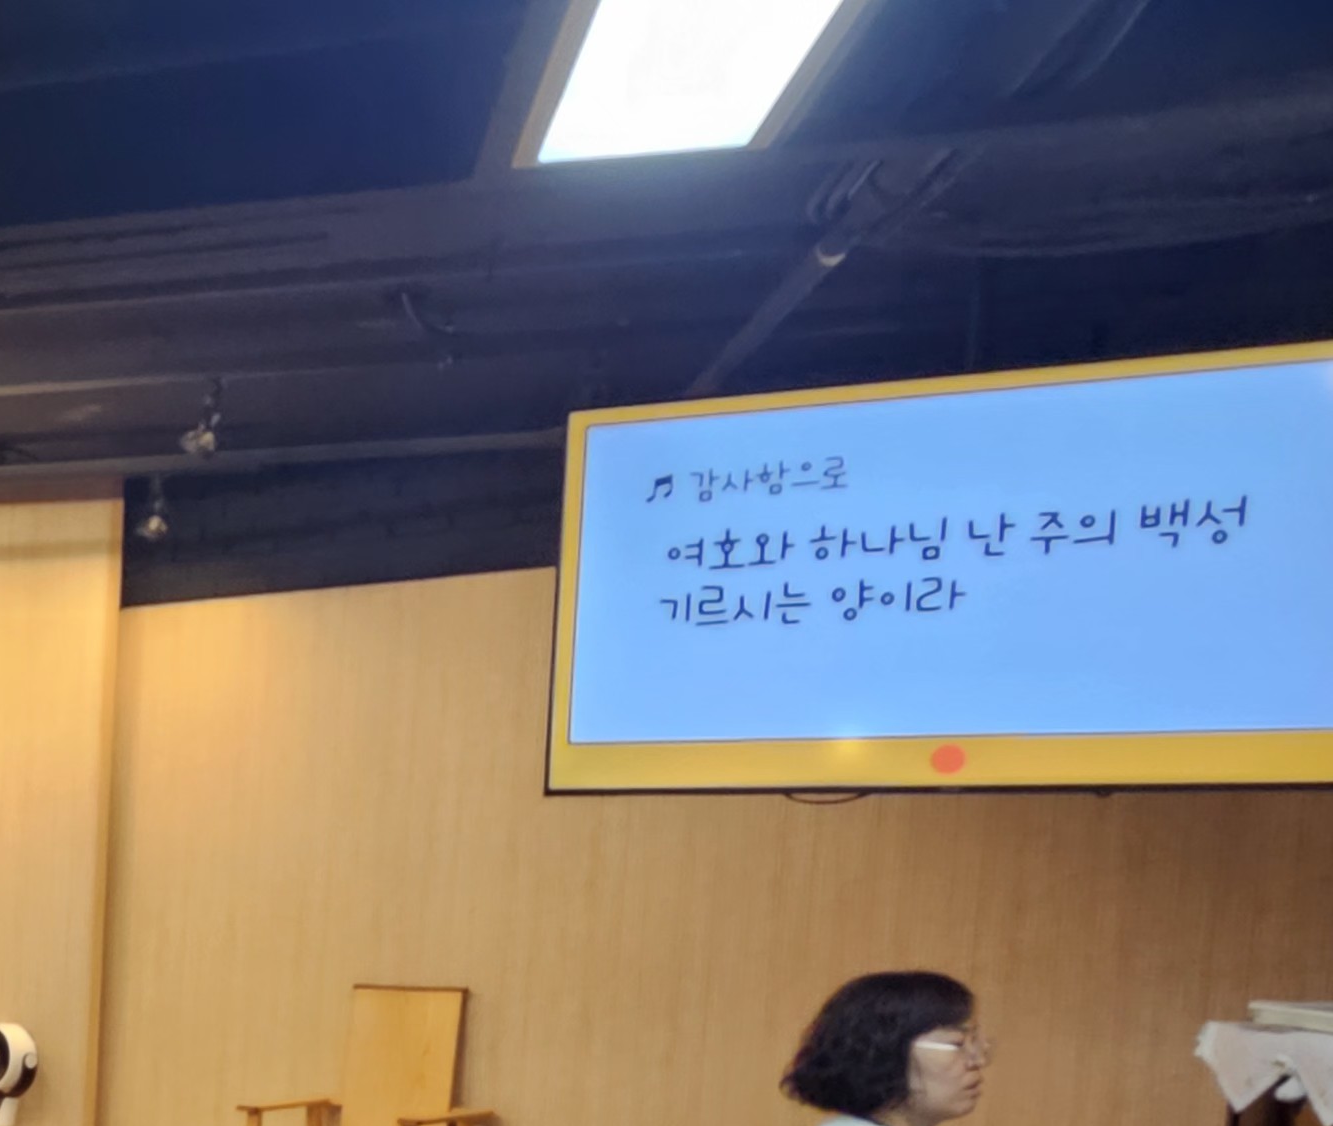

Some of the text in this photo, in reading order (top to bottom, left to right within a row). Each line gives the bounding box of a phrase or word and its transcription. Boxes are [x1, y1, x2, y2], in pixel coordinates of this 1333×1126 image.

[690, 456, 848, 503] 감사함으로
[667, 495, 1248, 570] 여호와 하나님 난 주의 백성
[660, 576, 967, 627] 기르시는 양이라
